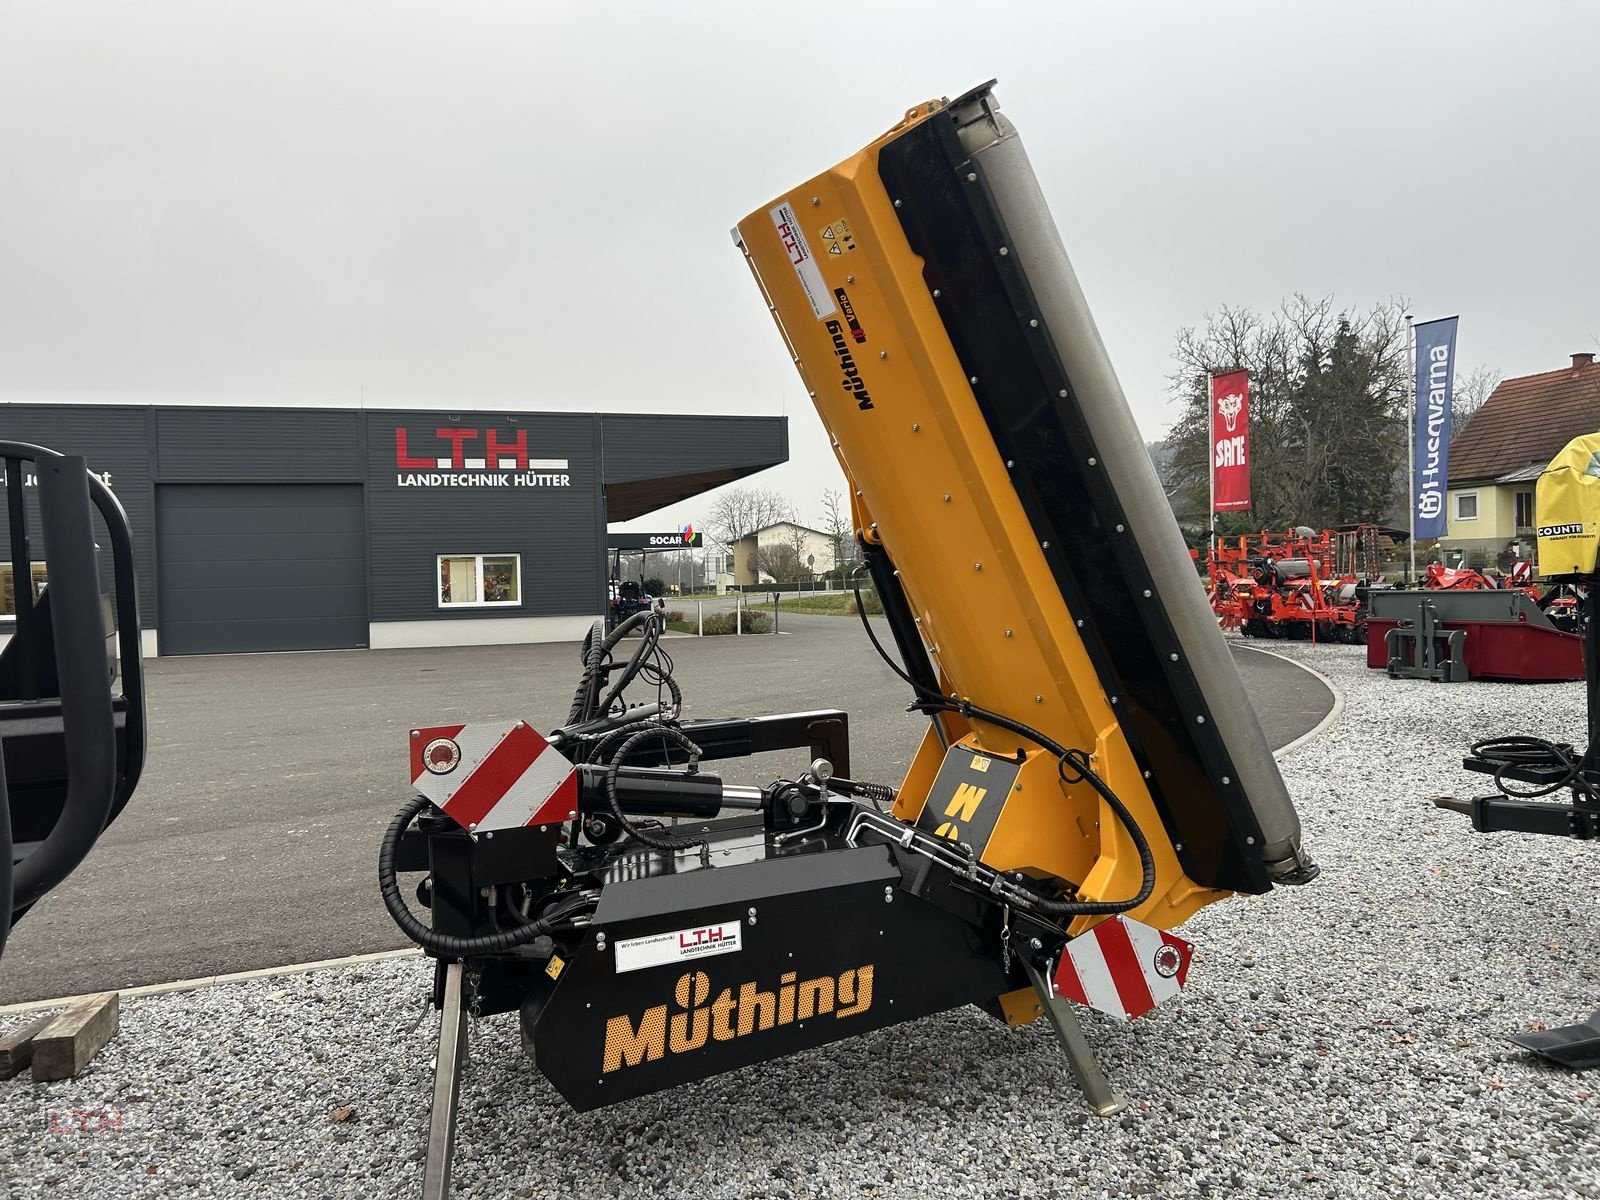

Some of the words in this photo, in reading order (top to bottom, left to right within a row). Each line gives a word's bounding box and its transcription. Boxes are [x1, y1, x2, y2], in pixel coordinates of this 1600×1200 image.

[839, 294, 856, 322] Vario
[825, 319, 874, 411] Müthing
[1422, 344, 1448, 489] Husqvarna
[1215, 435, 1246, 468] SAME
[397, 473, 510, 487] LANDTECHNIK
[514, 470, 571, 487] HÜTTER
[649, 536, 683, 545] SOCAR
[680, 943, 717, 955] LANDTECHNIK
[717, 940, 737, 949] HÜTTER
[602, 963, 875, 1074] Müthing
